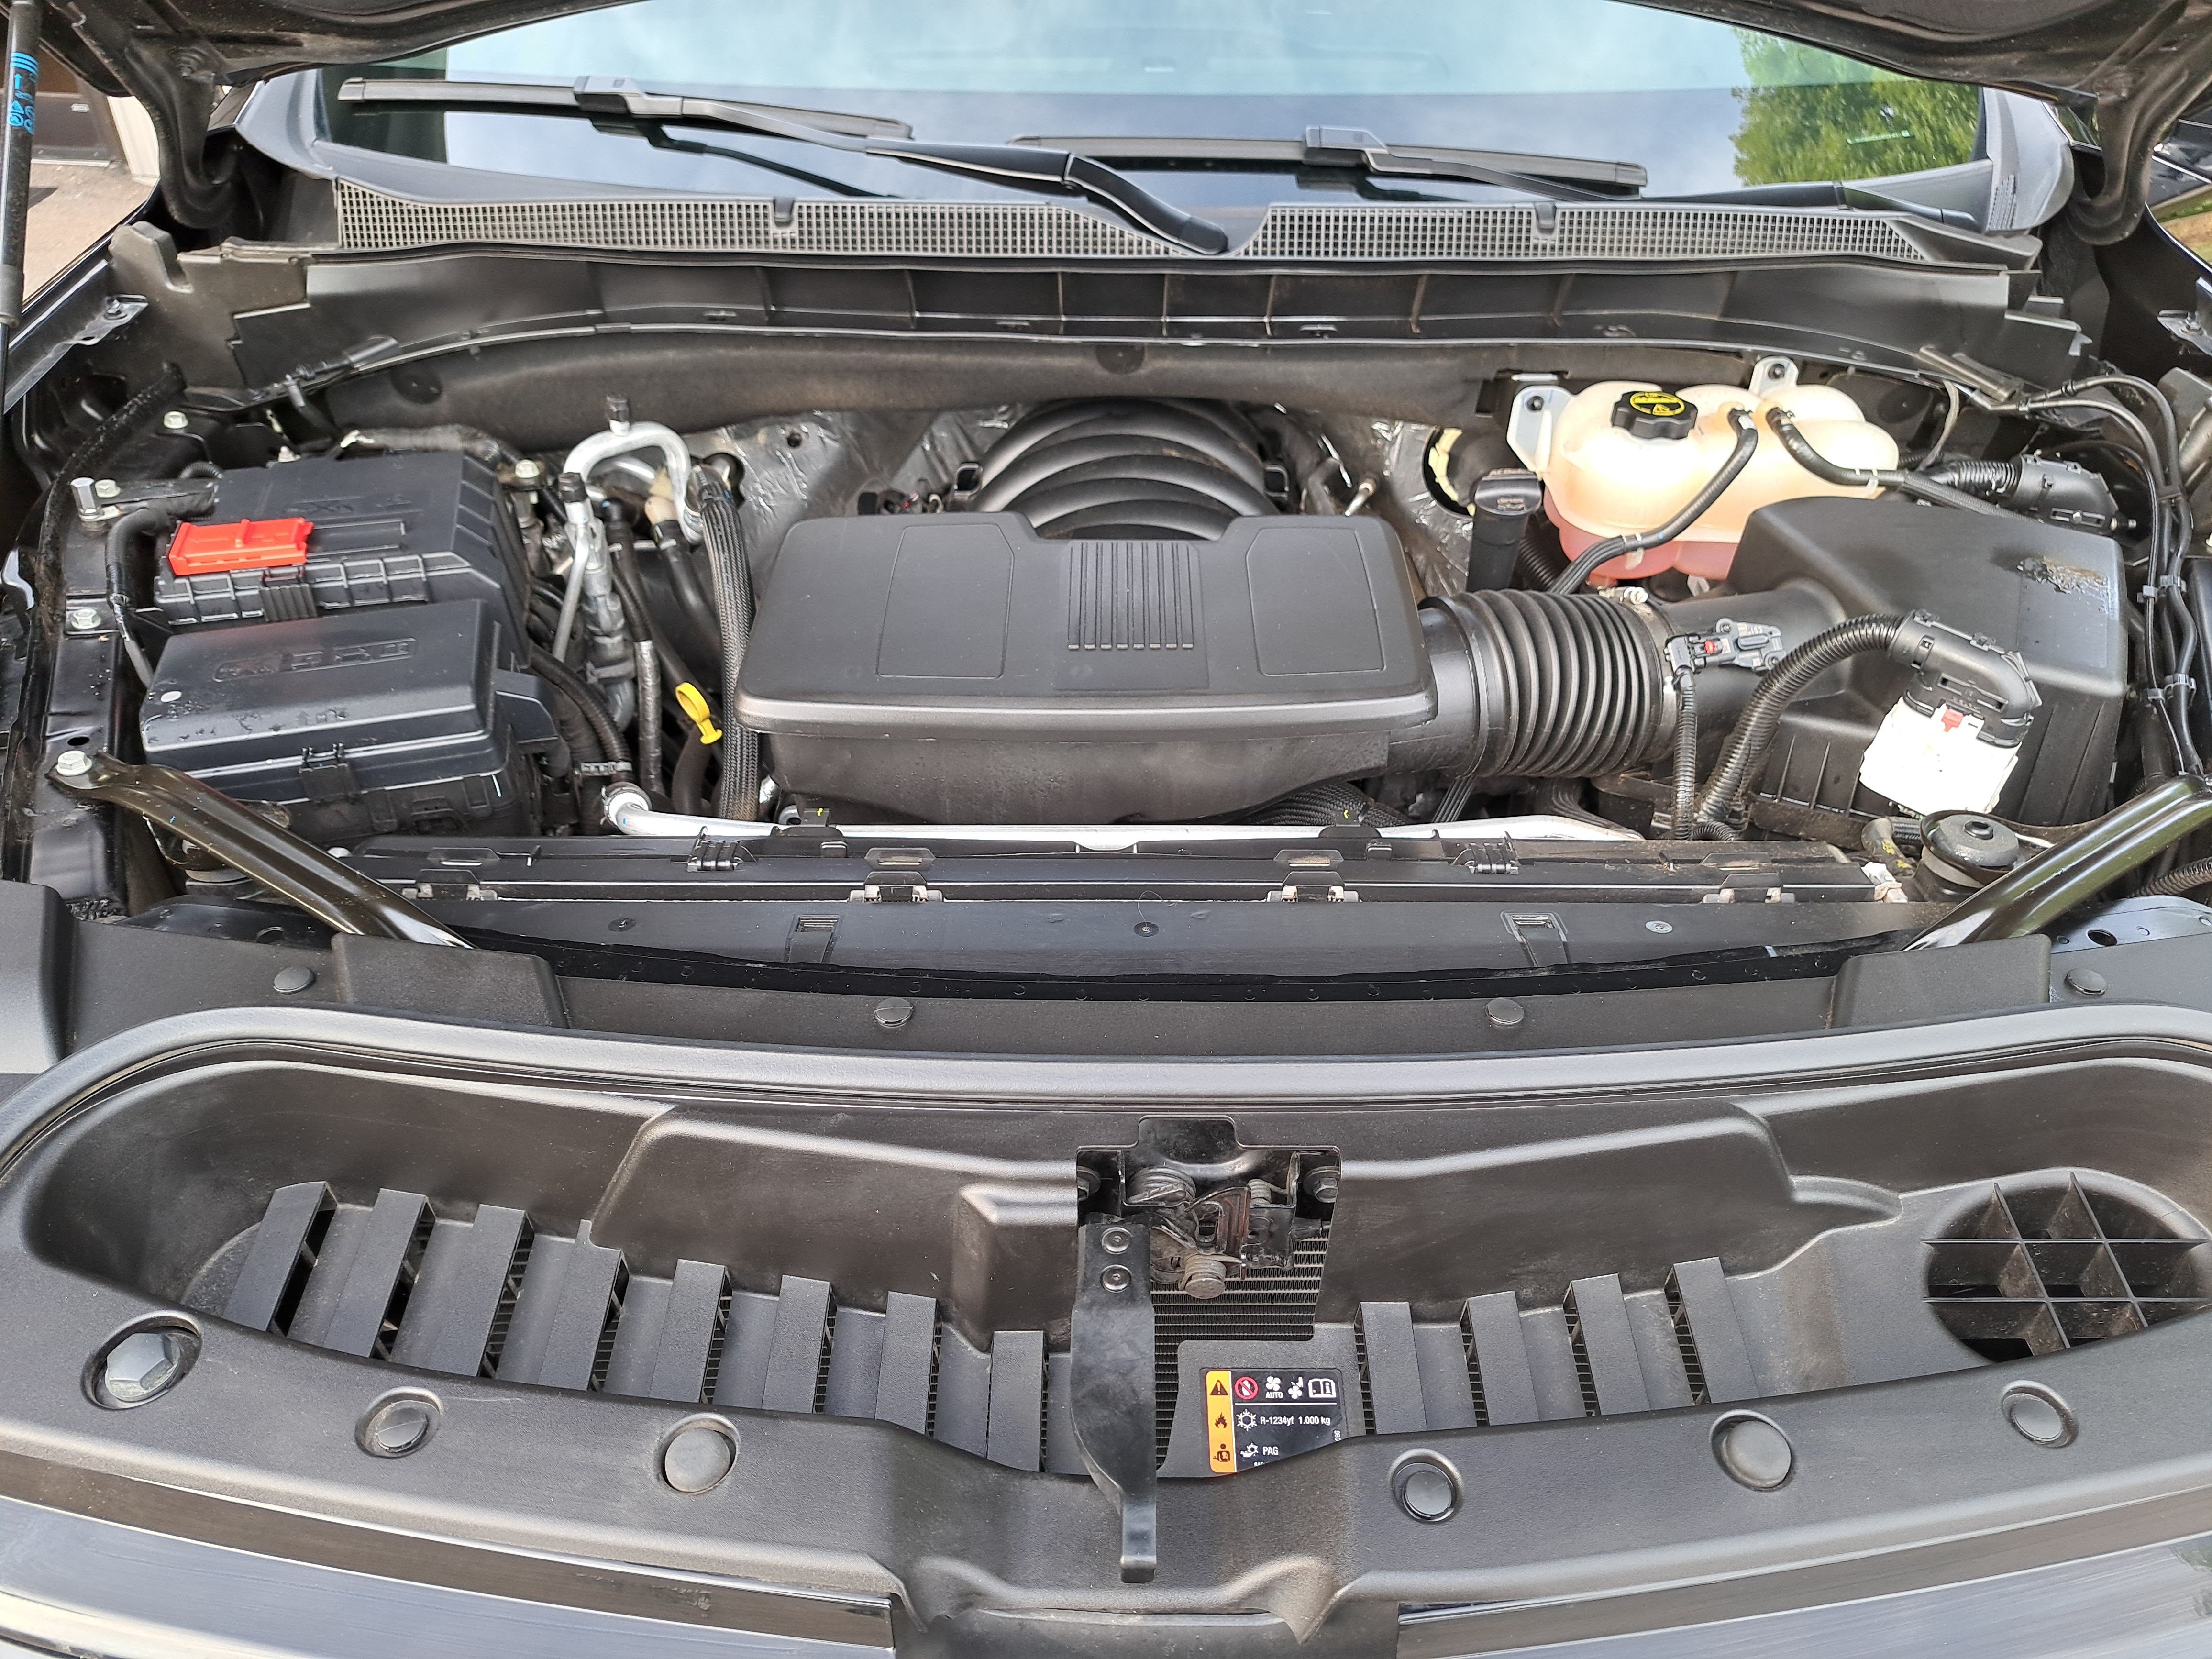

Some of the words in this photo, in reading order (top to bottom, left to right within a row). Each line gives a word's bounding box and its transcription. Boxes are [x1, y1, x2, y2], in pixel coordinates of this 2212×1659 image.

[1260, 1416, 1294, 1426] R-1234yf
[1298, 1416, 1319, 1424] 1.000
[1321, 1416, 1331, 1426] kg
[1262, 1446, 1279, 1456] PAG
